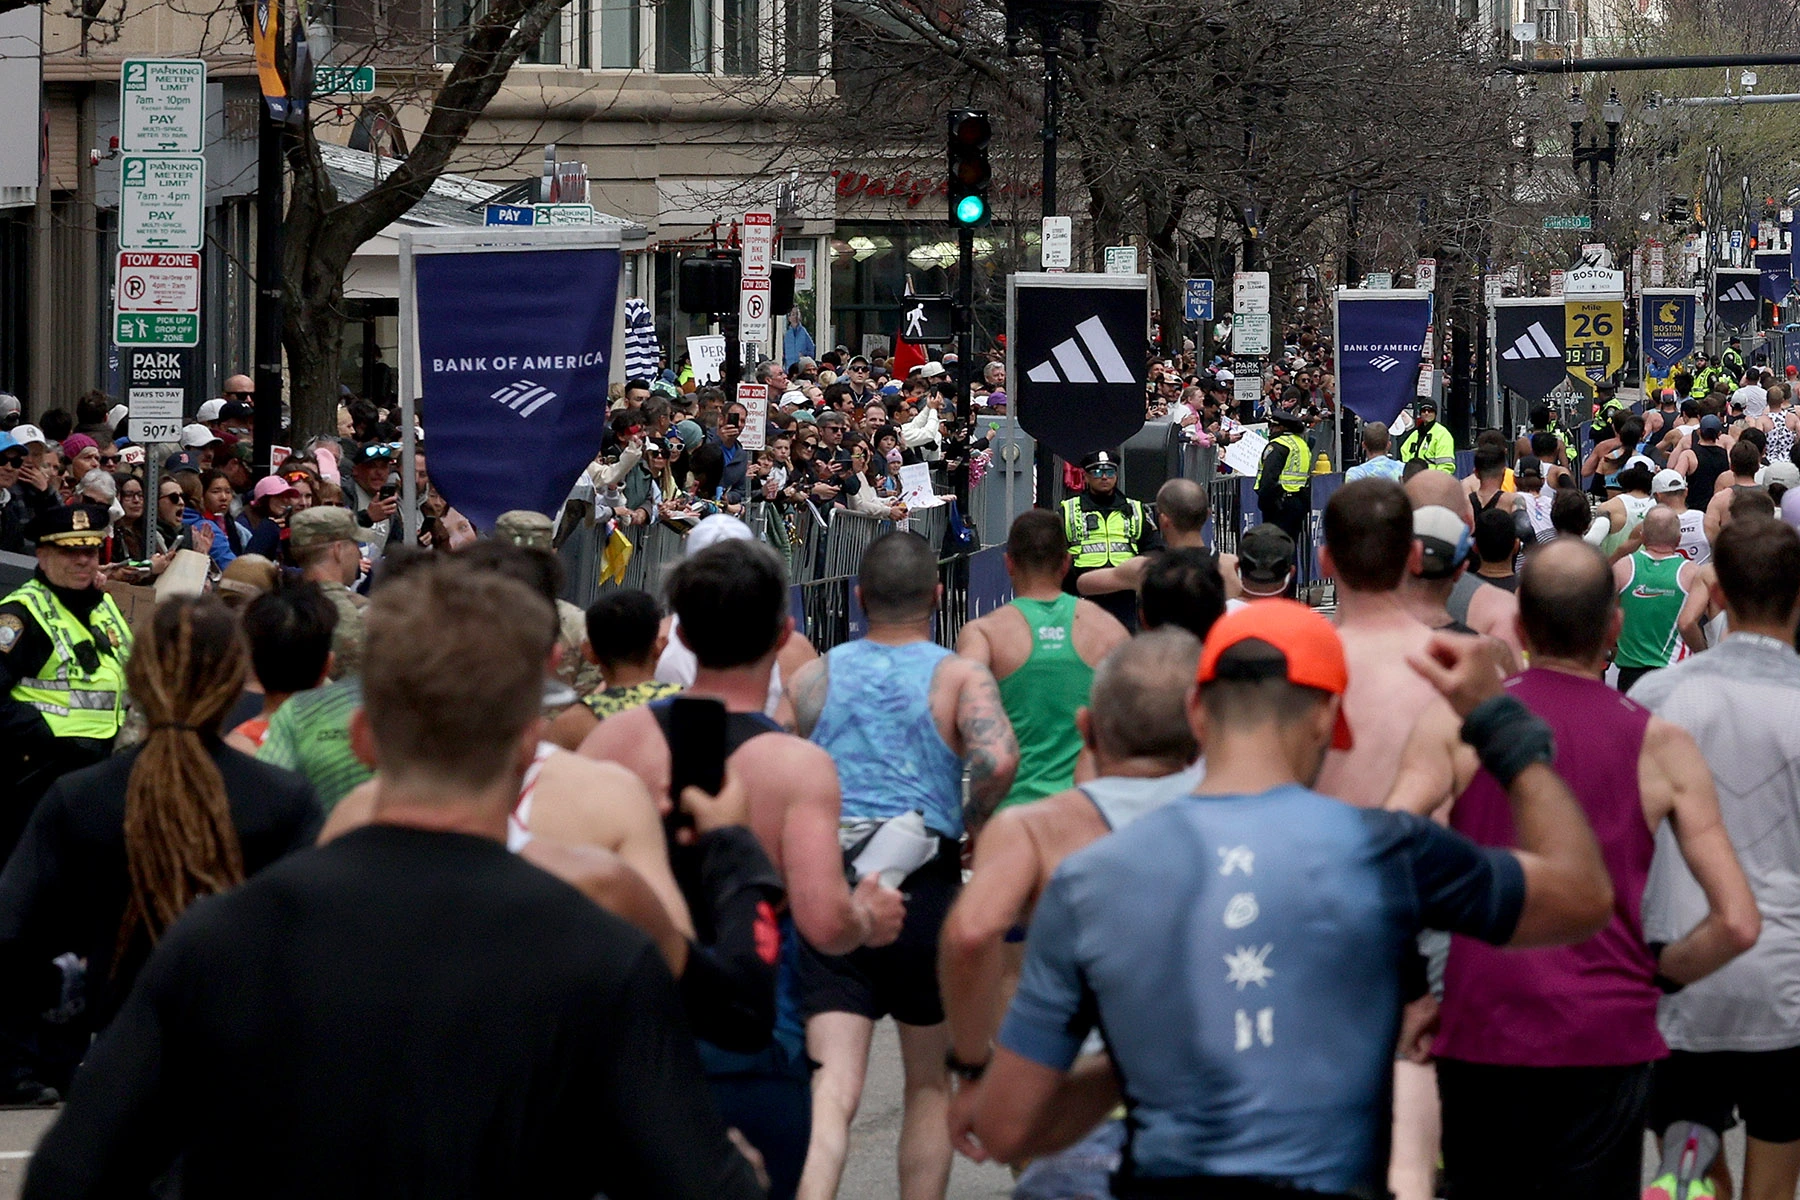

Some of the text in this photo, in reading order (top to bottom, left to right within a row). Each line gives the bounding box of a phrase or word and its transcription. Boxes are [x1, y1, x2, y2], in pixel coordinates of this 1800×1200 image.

[128, 64, 145, 82] 2
[357, 80, 367, 90] ST
[136, 95, 154, 104] 7am
[167, 96, 190, 105] 10pm
[150, 115, 176, 124] PAY
[127, 161, 144, 179] 2
[137, 192, 157, 200] 7am
[168, 192, 190, 201] 4pm
[149, 212, 175, 220] PAY
[499, 209, 521, 221] PAY
[537, 208, 548, 223] 2
[1107, 250, 1114, 259] 2
[126, 255, 193, 266] TOW ZONE
[1573, 270, 1613, 281] BOSTON
[1235, 315, 1243, 324] 2
[1572, 313, 1613, 337] 26
[133, 354, 180, 368] PARK
[433, 351, 603, 372] BANK OF AMERICA
[133, 369, 180, 379] BOSTON
[751, 389, 765, 397] ZONE
[143, 426, 167, 436] 907
